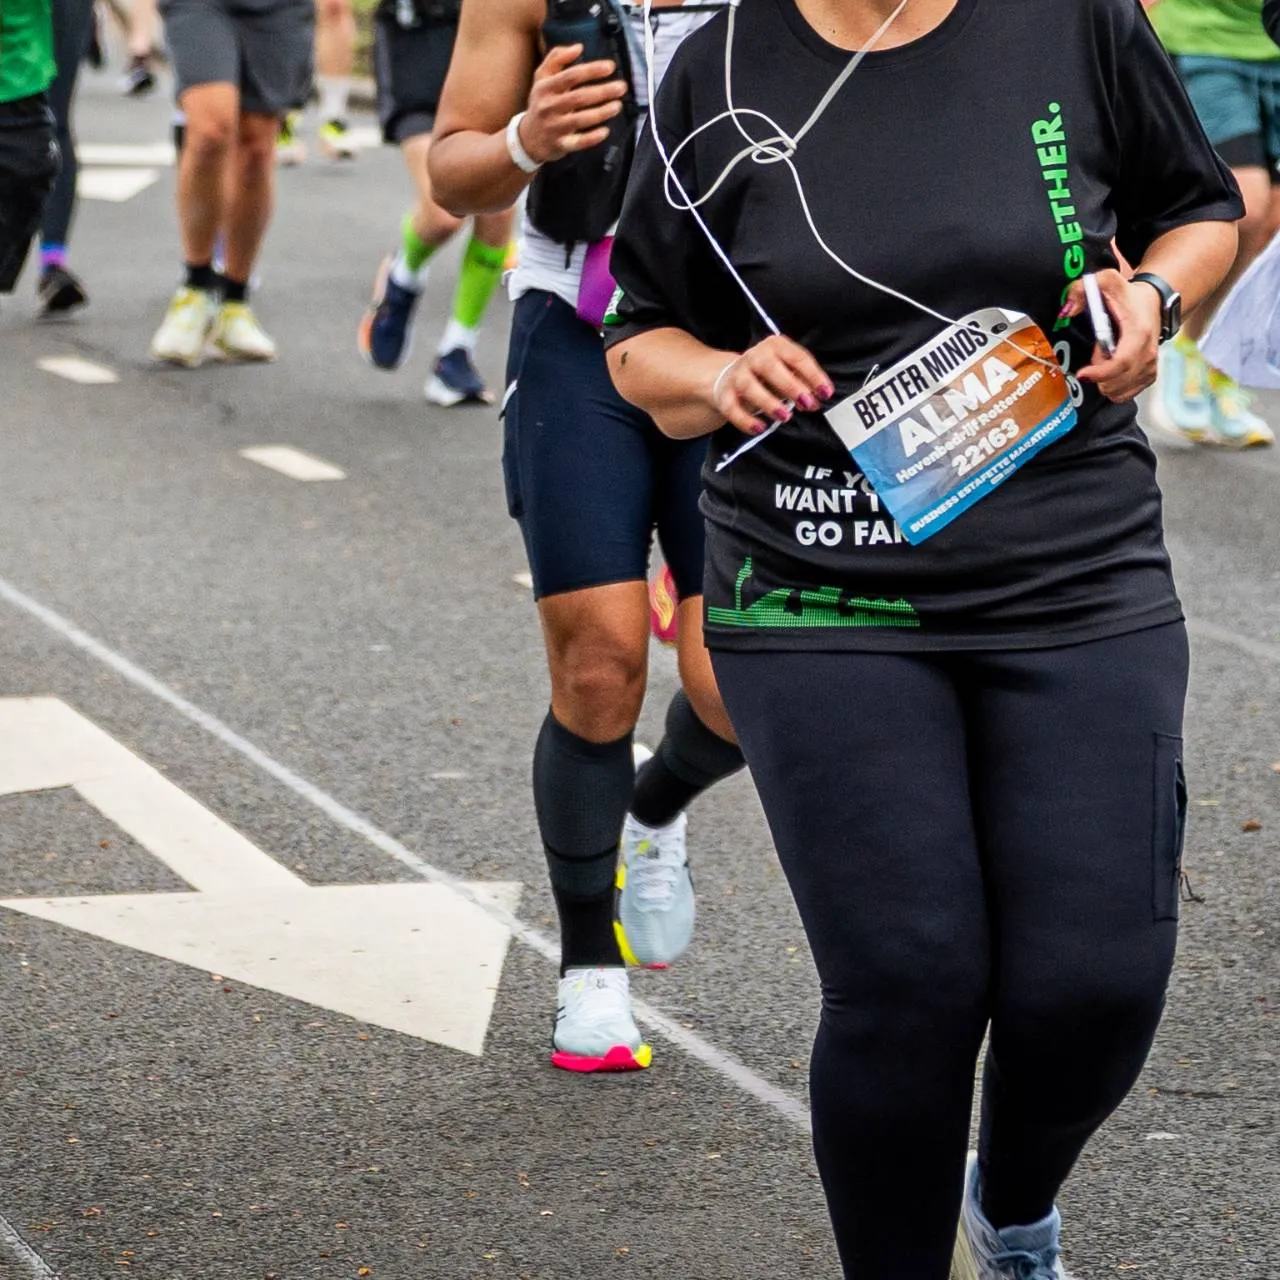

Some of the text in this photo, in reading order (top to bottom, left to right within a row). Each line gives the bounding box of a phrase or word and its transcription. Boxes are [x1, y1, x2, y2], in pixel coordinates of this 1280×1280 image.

[853, 320, 989, 429] BETTER MINDS
[976, 370, 1043, 426] Rotterdam
[897, 356, 1018, 457] ALMA
[804, 465, 833, 480] IF
[909, 495, 960, 533] BUSINESS
[958, 456, 1011, 499] ESTAFETTE
[1009, 416, 1061, 460] MARATHON
[952, 417, 1020, 477] 22163
[775, 484, 857, 514] WANT
[795, 520, 843, 547] GO
